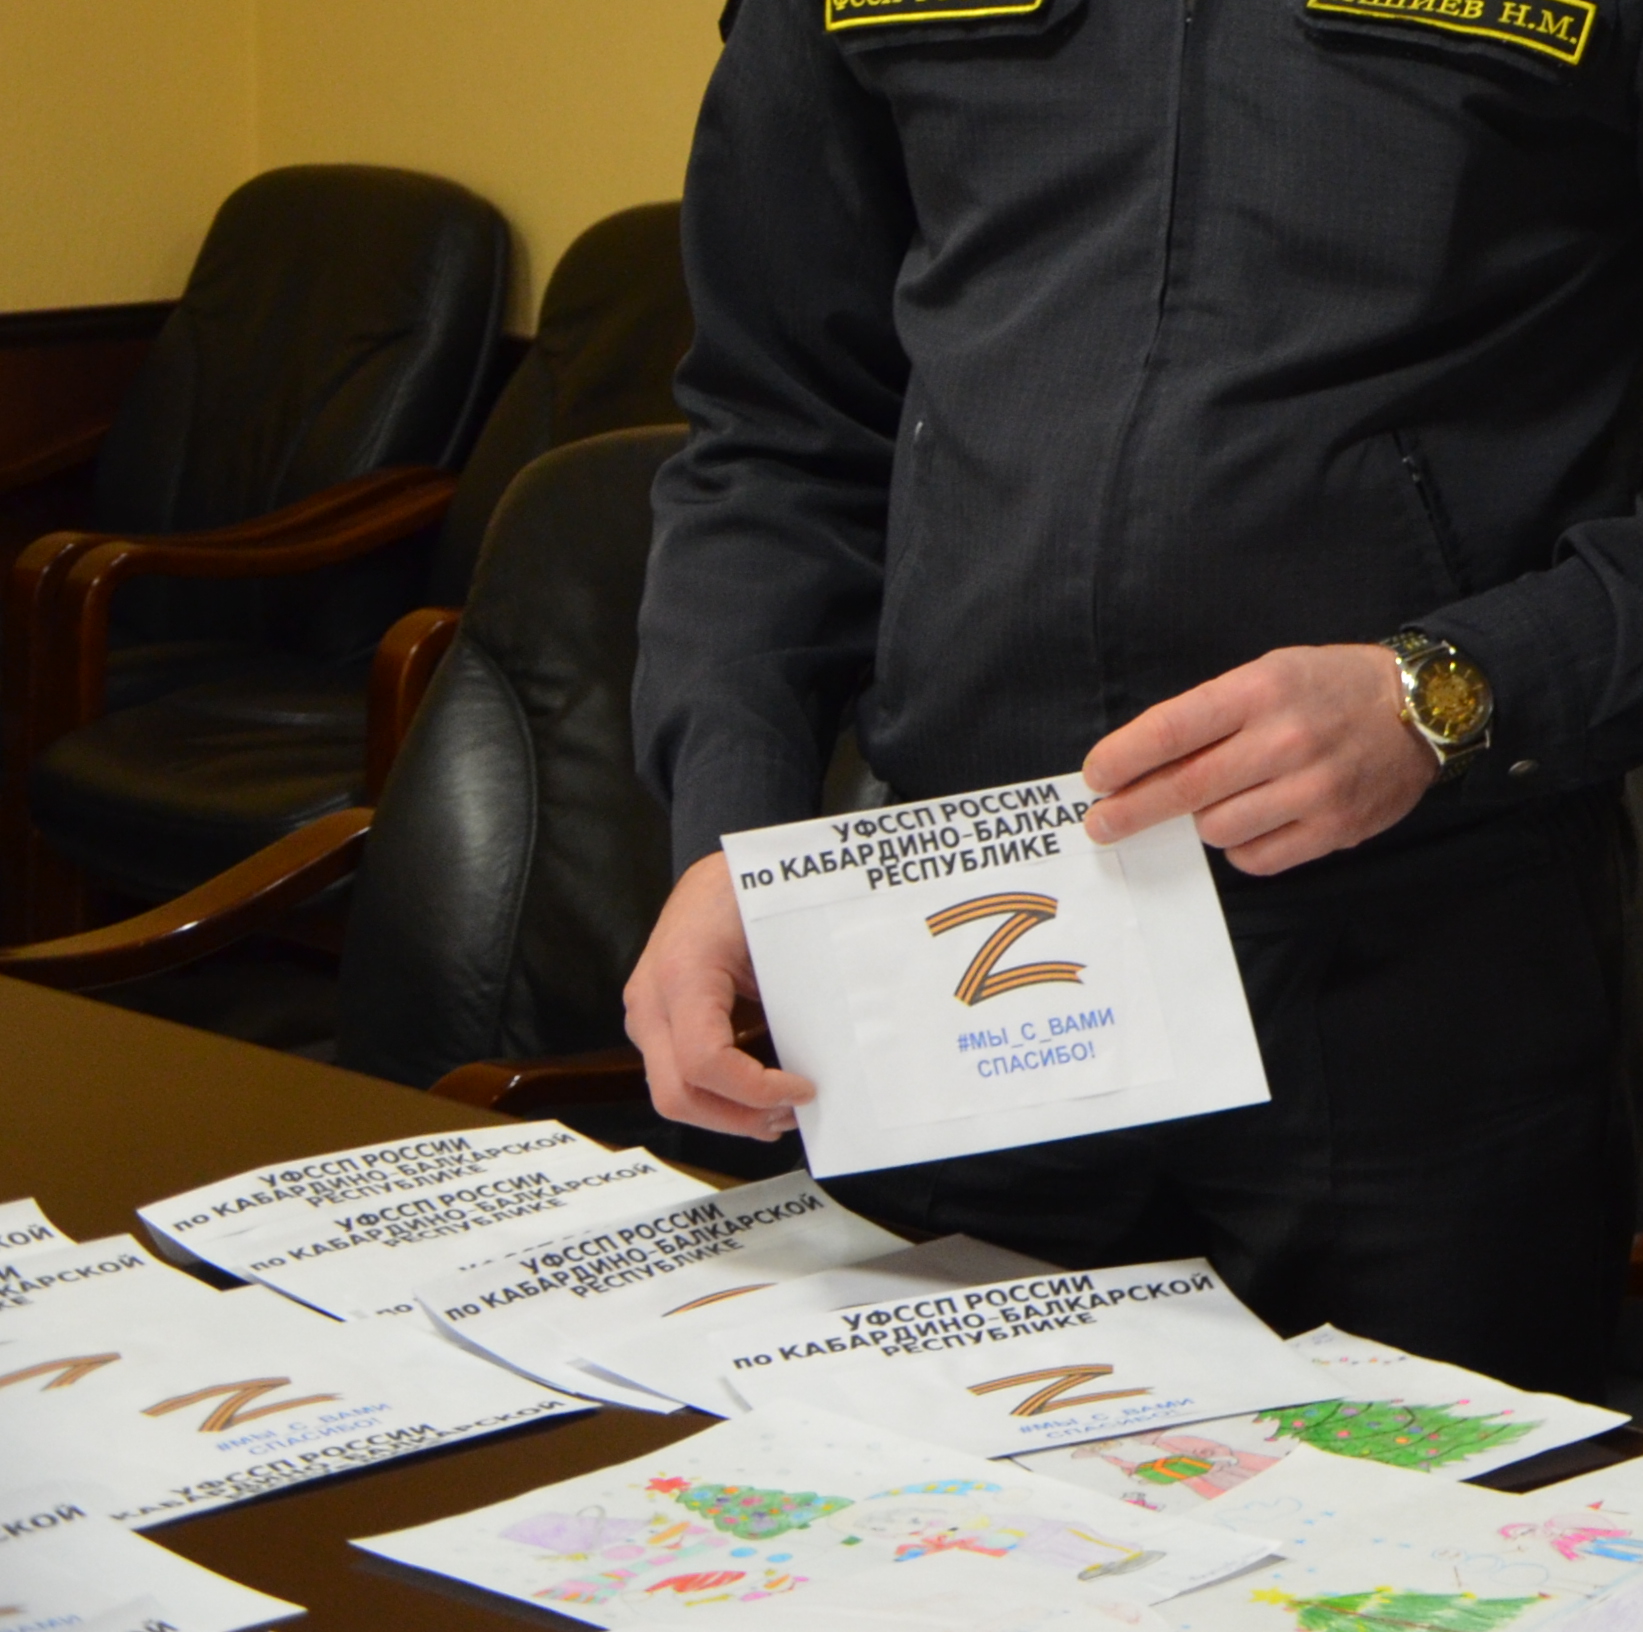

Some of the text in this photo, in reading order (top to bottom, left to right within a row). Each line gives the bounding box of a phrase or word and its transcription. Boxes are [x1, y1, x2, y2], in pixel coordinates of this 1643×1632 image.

[1498, 1, 1578, 45] Н.М.
[832, 783, 1061, 844] УФССП РОССИИ
[740, 798, 1098, 890] по КАБАРДИНО-БАЛКАР
[867, 833, 1061, 890] РЕСПУБЛИКЕ
[977, 1041, 1096, 1078] СПАСИБО!
[173, 1132, 577, 1232] по КАБАРДИНО-БАЛКАРСКОЙ
[258, 1136, 473, 1189] УФССП РОССИИ
[305, 1164, 490, 1209] РЕСПУБЛИКЕ
[250, 1256, 287, 1272] по
[288, 1162, 658, 1261] КАБАРДИНО-БАЛКАРСКОЙ
[334, 1171, 552, 1232] УФССП РОССИИ
[382, 1197, 569, 1248] РЕСПУБЛИКЕ
[445, 1303, 482, 1321] по
[480, 1192, 825, 1310] КАБАРДИНО-БАЛКАРСКОЙ
[519, 1234, 620, 1275] УФССП
[617, 1202, 725, 1246] РОССИИ
[570, 1237, 746, 1299] РЕСПУБЛИКЕ
[732, 1272, 1215, 1370] по КАБАРДИНО-БАЛКАРСКОЙ
[841, 1274, 1096, 1332] УФССП РОССИИ
[882, 1311, 1099, 1358] РЕСПУБЛИКЕ
[298, 1423, 436, 1463] РОССИИ
